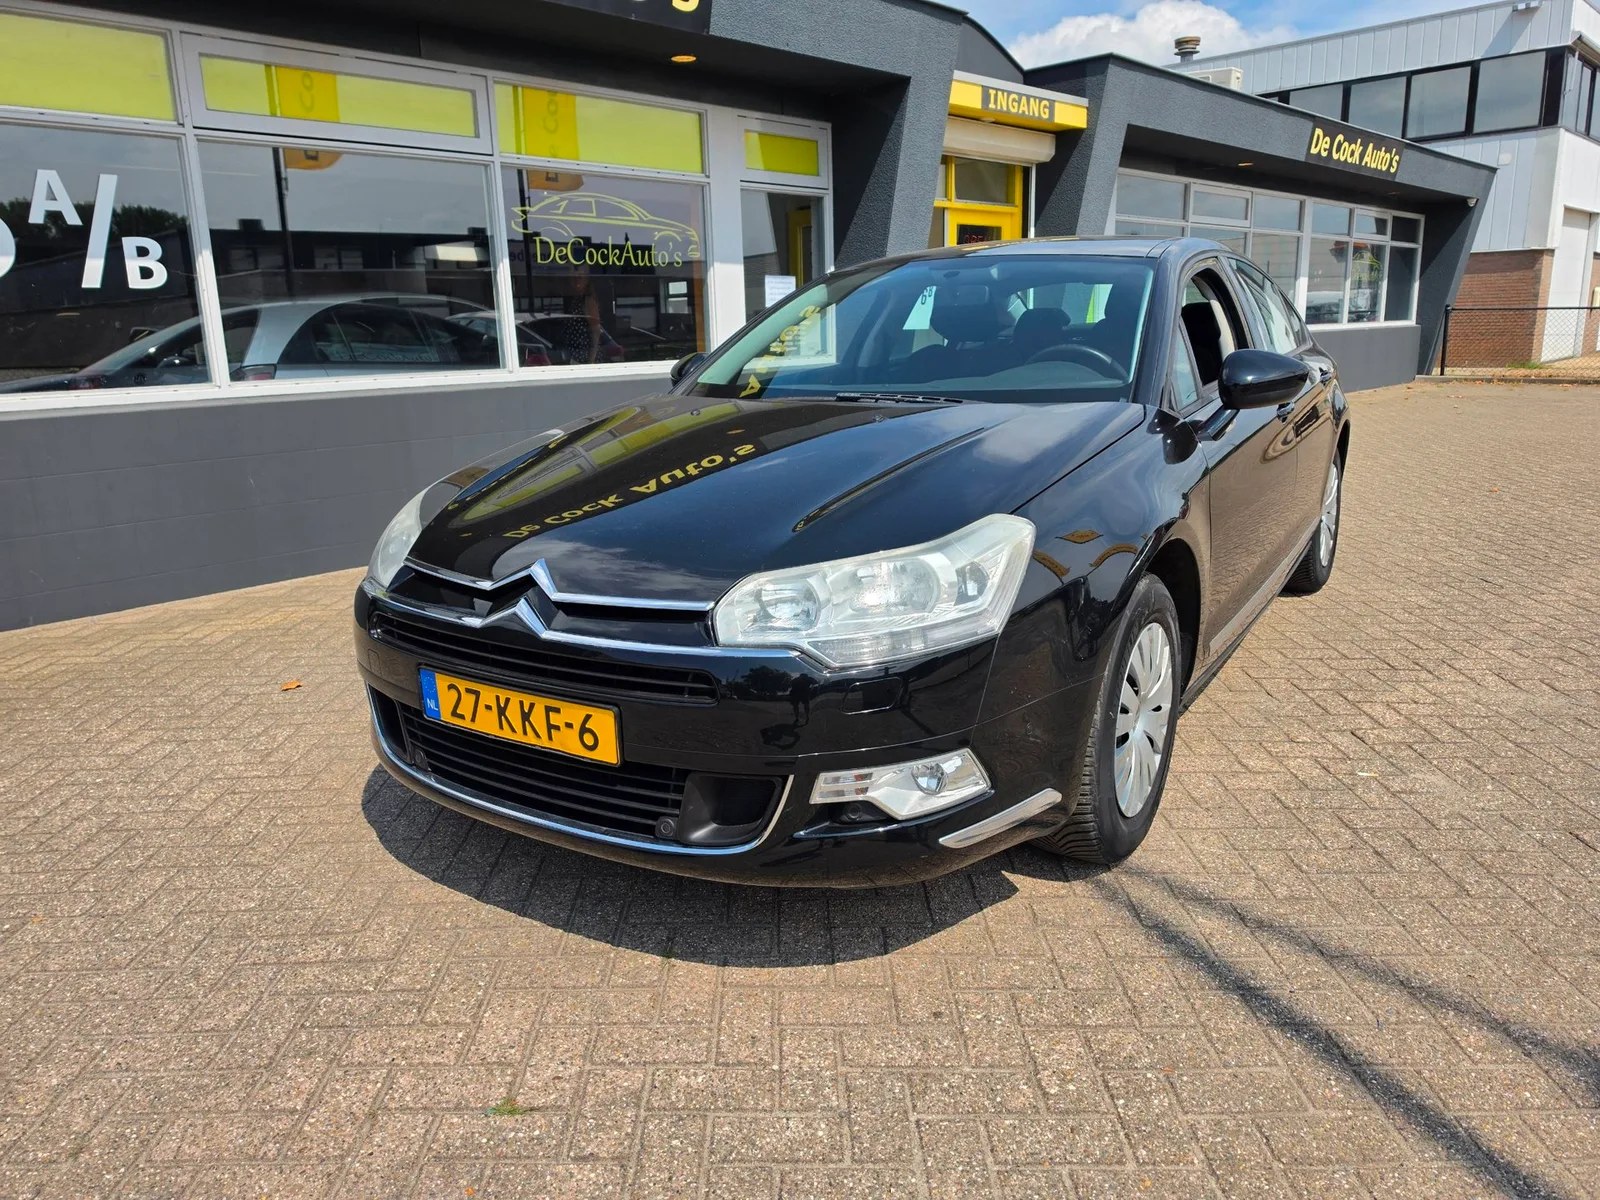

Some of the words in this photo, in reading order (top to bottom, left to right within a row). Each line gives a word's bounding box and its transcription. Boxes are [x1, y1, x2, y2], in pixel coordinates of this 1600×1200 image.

[988, 88, 1050, 119] INGANG
[1310, 128, 1331, 157] De
[1332, 133, 1363, 165] Cock
[1361, 142, 1400, 173] Auto's
[532, 235, 683, 268] DeCockAuto's
[426, 698, 439, 712] NL
[447, 683, 600, 752] 27-KKF-6
